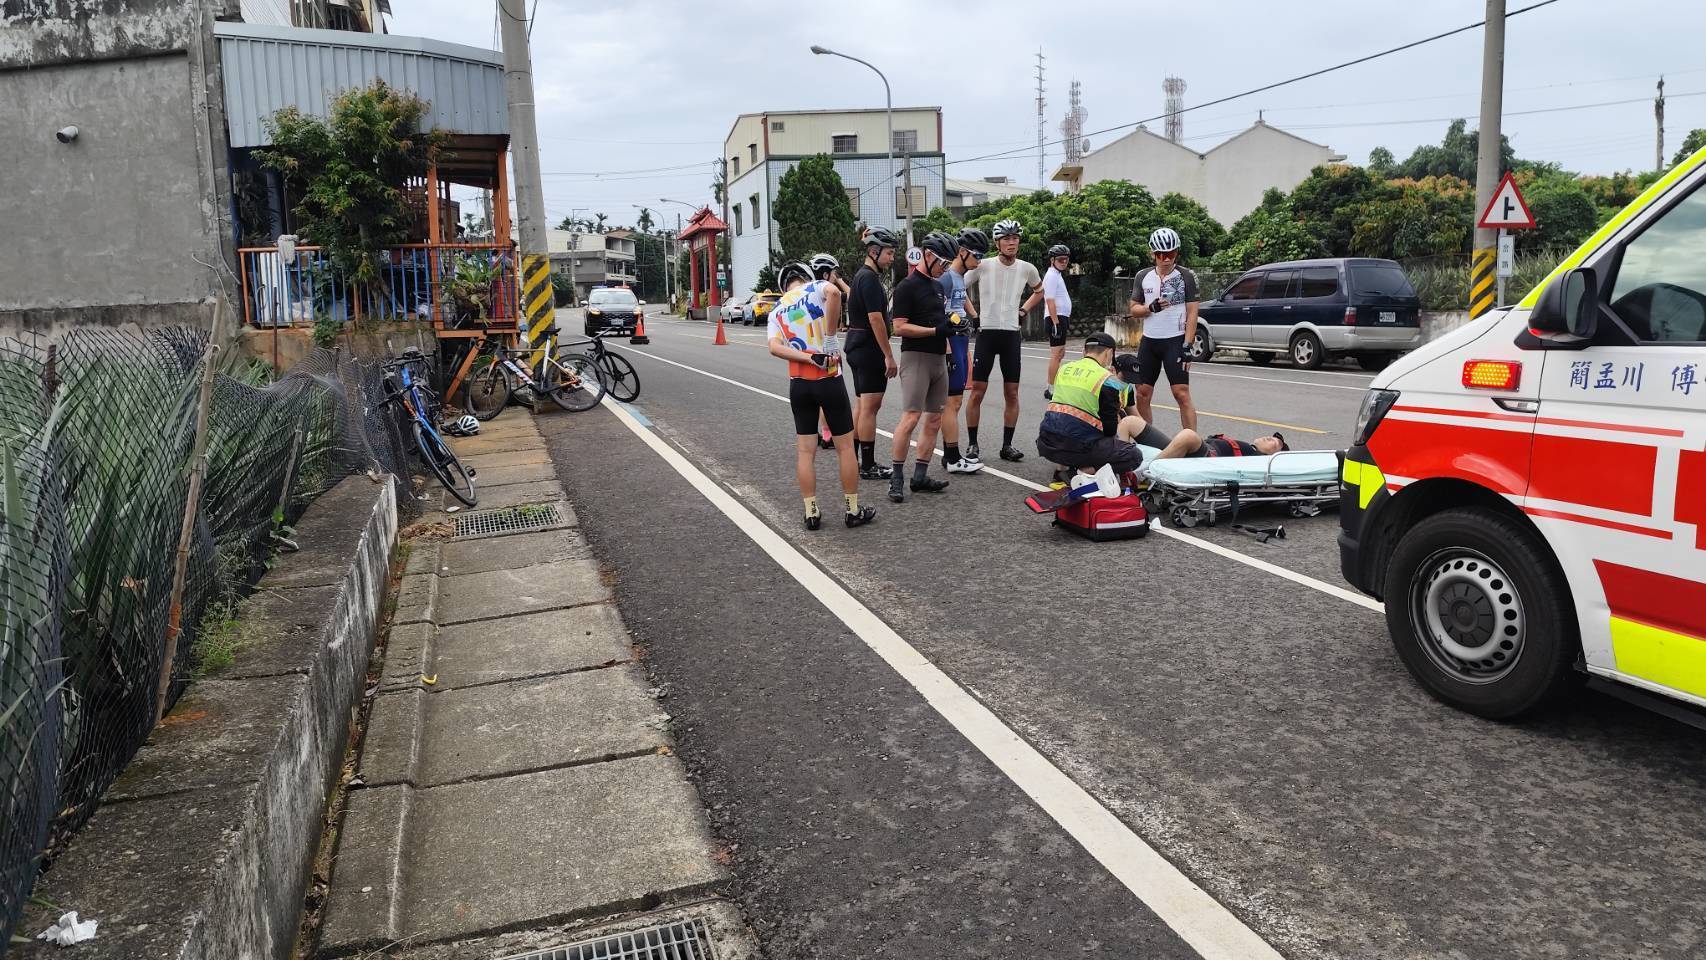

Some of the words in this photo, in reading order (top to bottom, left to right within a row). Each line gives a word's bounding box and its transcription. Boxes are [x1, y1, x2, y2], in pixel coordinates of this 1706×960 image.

[908, 251, 921, 261] 40
[1063, 366, 1095, 378] EMT
[1570, 361, 1645, 392] 簡孟川
[1671, 363, 1706, 395] 傅
